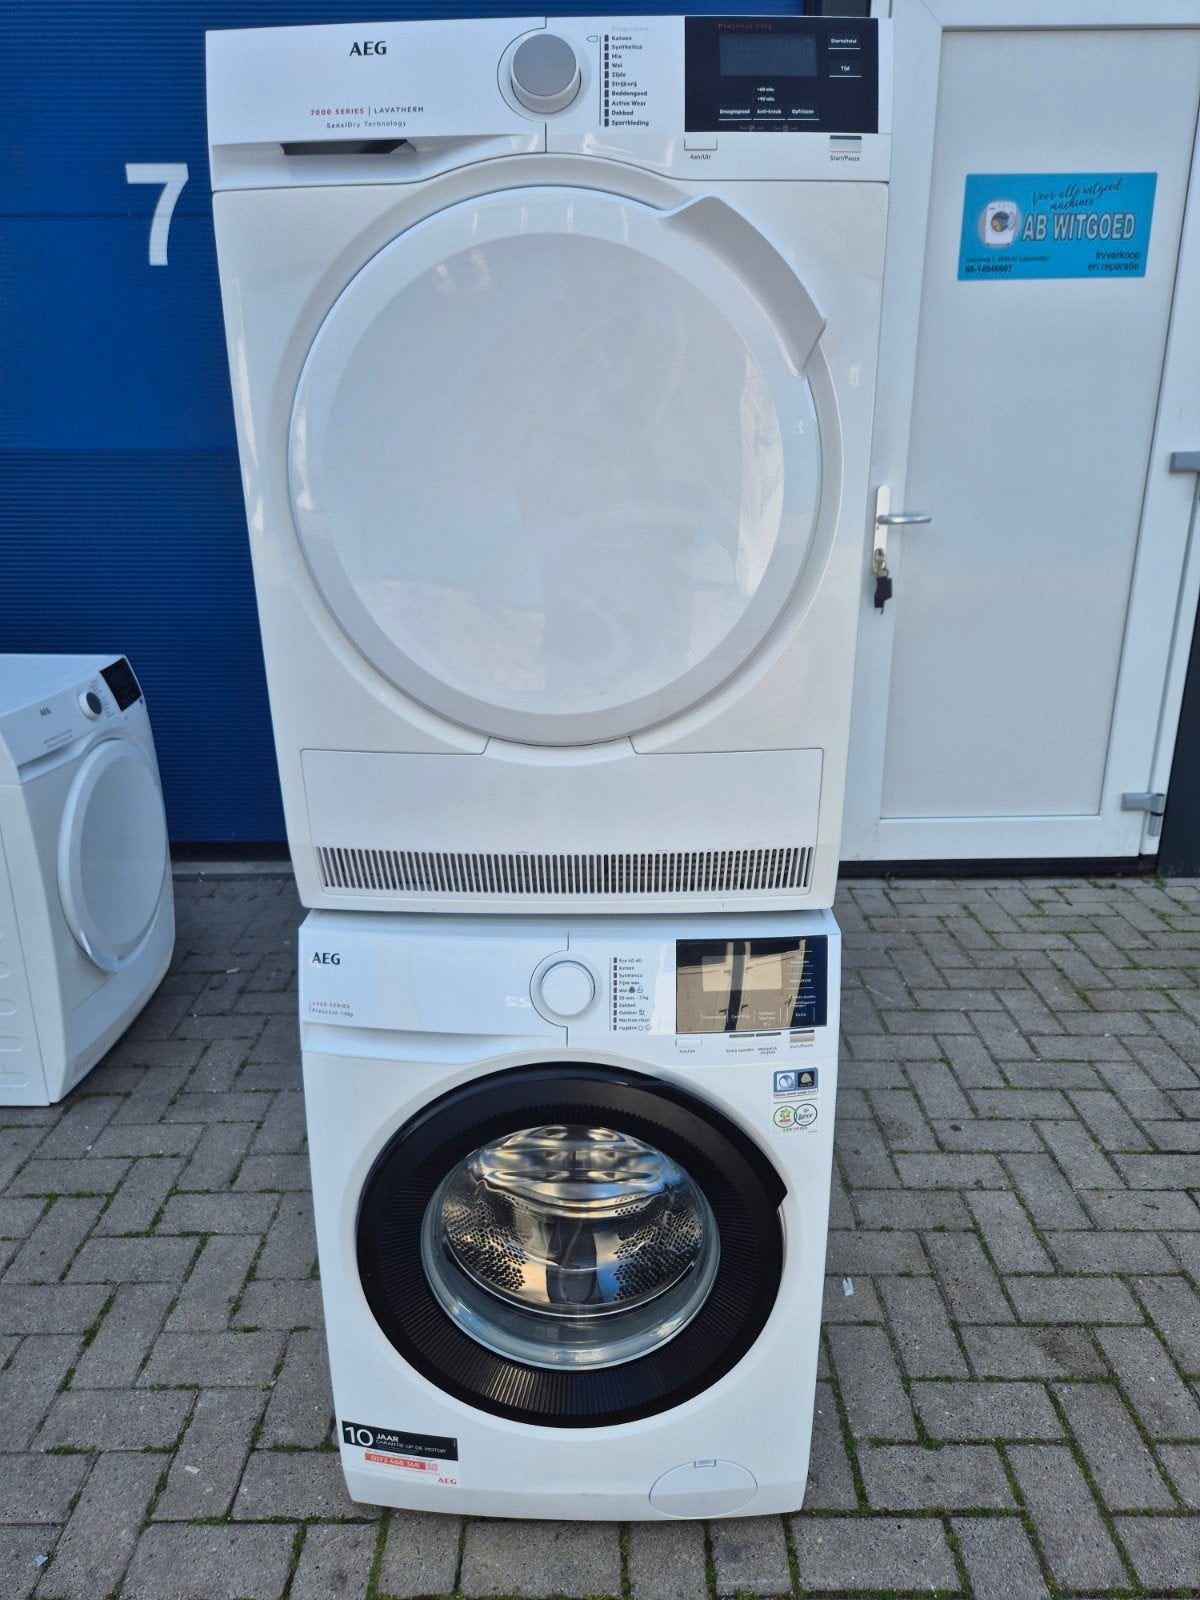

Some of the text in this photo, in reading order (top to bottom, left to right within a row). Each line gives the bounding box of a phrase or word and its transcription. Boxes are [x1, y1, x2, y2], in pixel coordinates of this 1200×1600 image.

[349, 40, 387, 57] AEG
[374, 106, 424, 114] LAVATHERM
[364, 120, 407, 128] Technology
[1058, 184, 1080, 199] alle
[1082, 178, 1123, 198] witgoed
[1050, 196, 1094, 211] machines
[125, 162, 189, 266] 7
[1021, 212, 1136, 242] AB WITGOED
[1101, 263, 1139, 273] reparatie
[311, 952, 341, 965] AEG
[345, 1426, 374, 1447] 10
[376, 1433, 399, 1443] JAAR
[376, 1440, 405, 1448] GARANTIE
[437, 1477, 457, 1485] AEG
